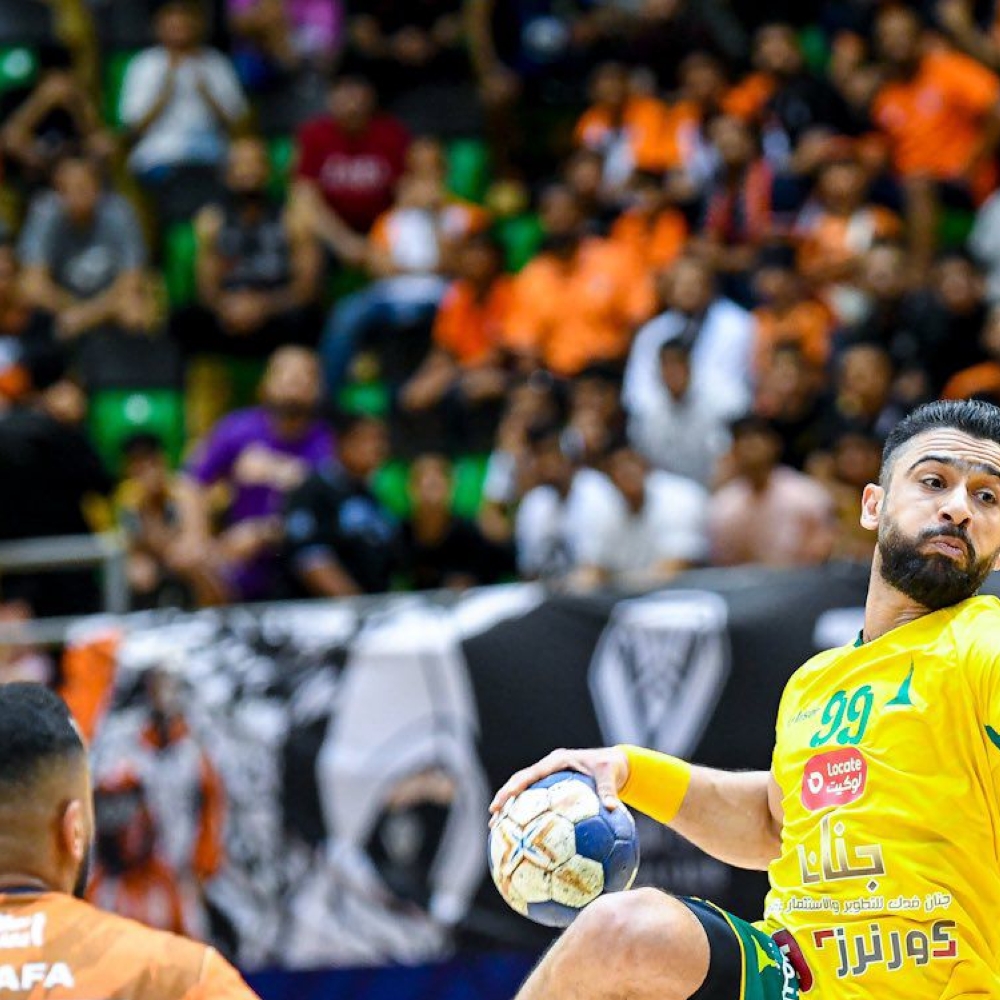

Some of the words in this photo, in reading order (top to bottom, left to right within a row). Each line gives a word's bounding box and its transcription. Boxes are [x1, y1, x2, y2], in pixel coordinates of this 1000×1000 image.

[809, 685, 874, 748] 99
[827, 757, 862, 777] Locate
[826, 773, 862, 796] لوكيت
